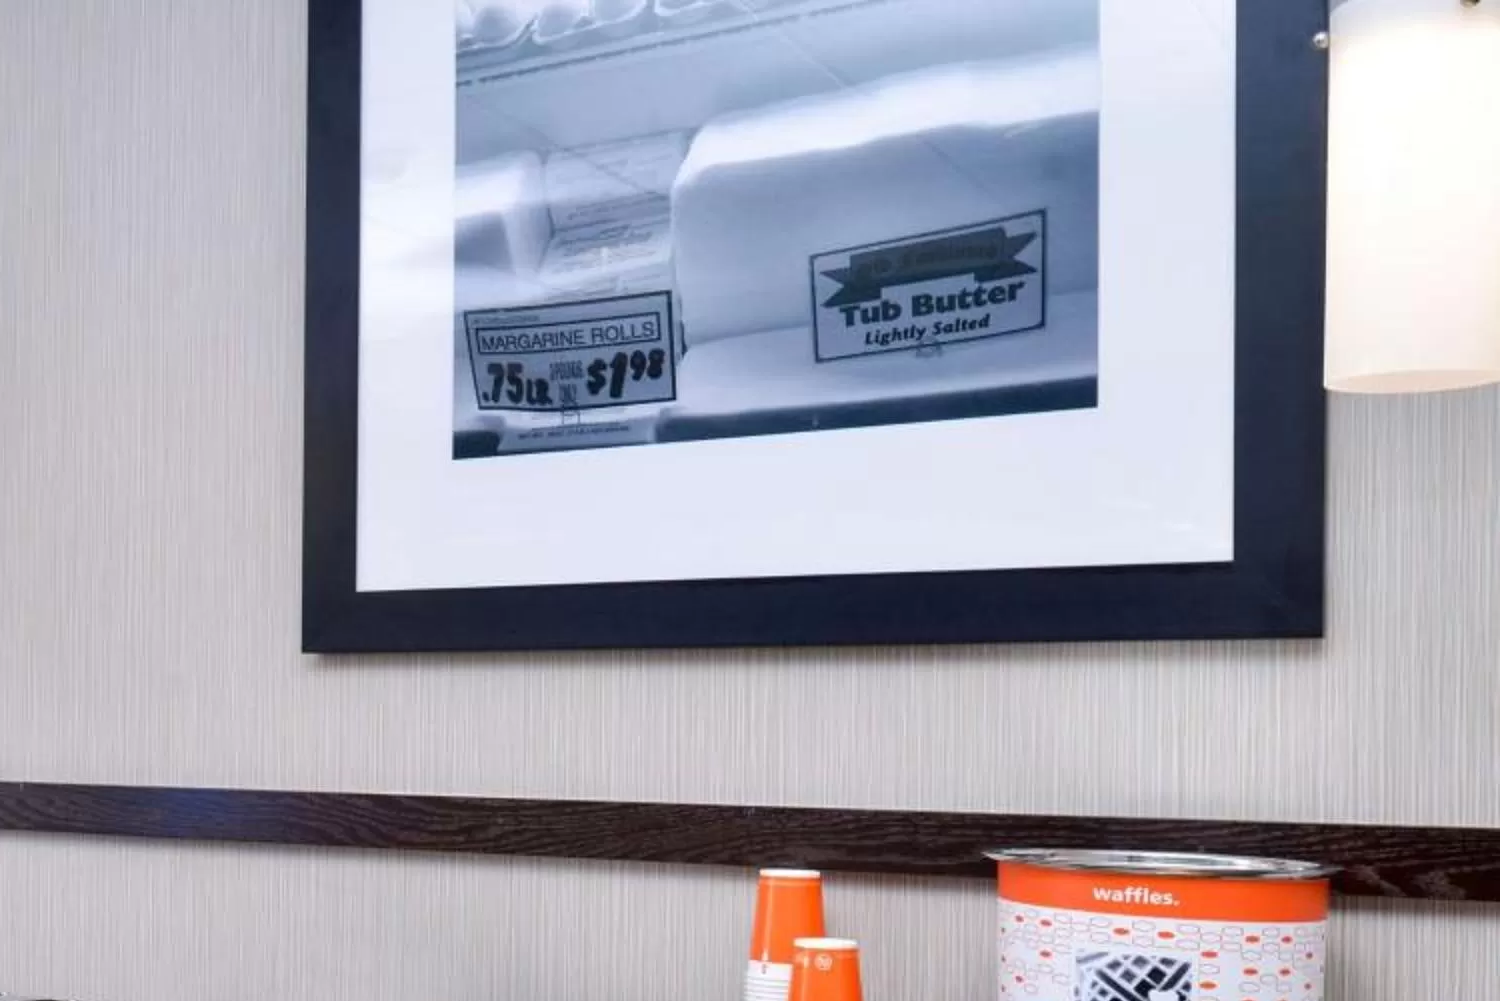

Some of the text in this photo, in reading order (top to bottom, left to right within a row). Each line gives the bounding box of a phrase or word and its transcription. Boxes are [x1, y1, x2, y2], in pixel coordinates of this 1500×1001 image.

[839, 280, 1025, 328] Tub Butter
[481, 321, 655, 351] MARGARINE ROLLS
[864, 313, 991, 346] Lightly Salted
[1092, 886, 1180, 907] waffles.
